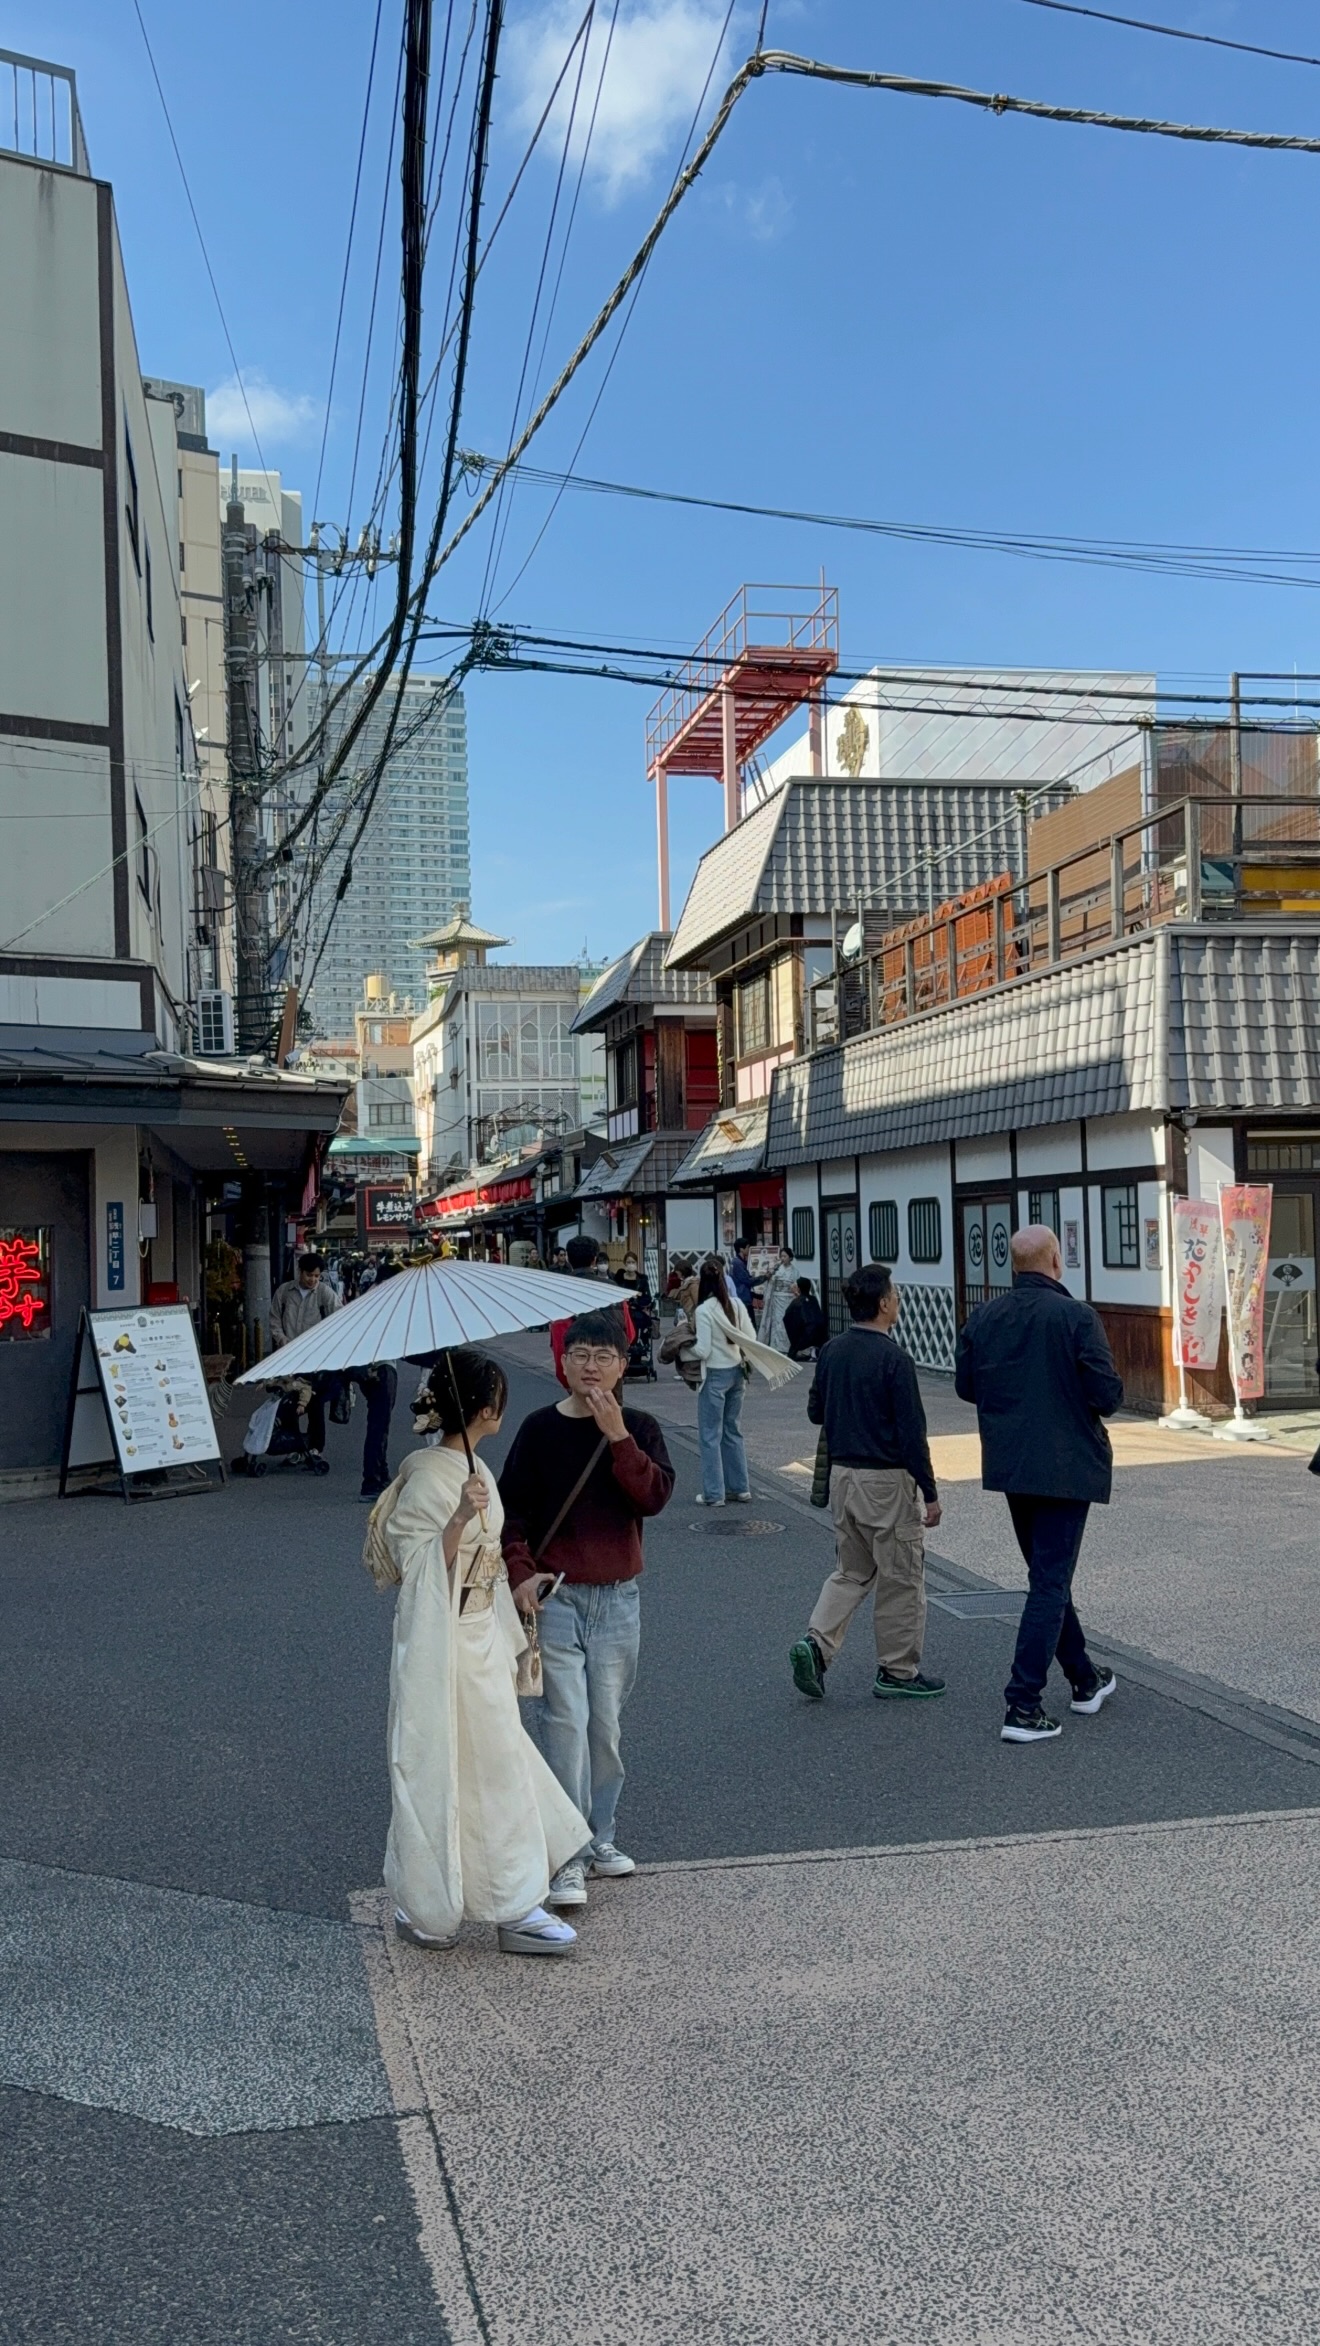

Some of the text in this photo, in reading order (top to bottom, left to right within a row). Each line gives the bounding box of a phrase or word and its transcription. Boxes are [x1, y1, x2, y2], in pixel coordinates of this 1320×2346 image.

[112, 1275, 120, 1285] 7
[1181, 1238, 1208, 1326] 花やしき
